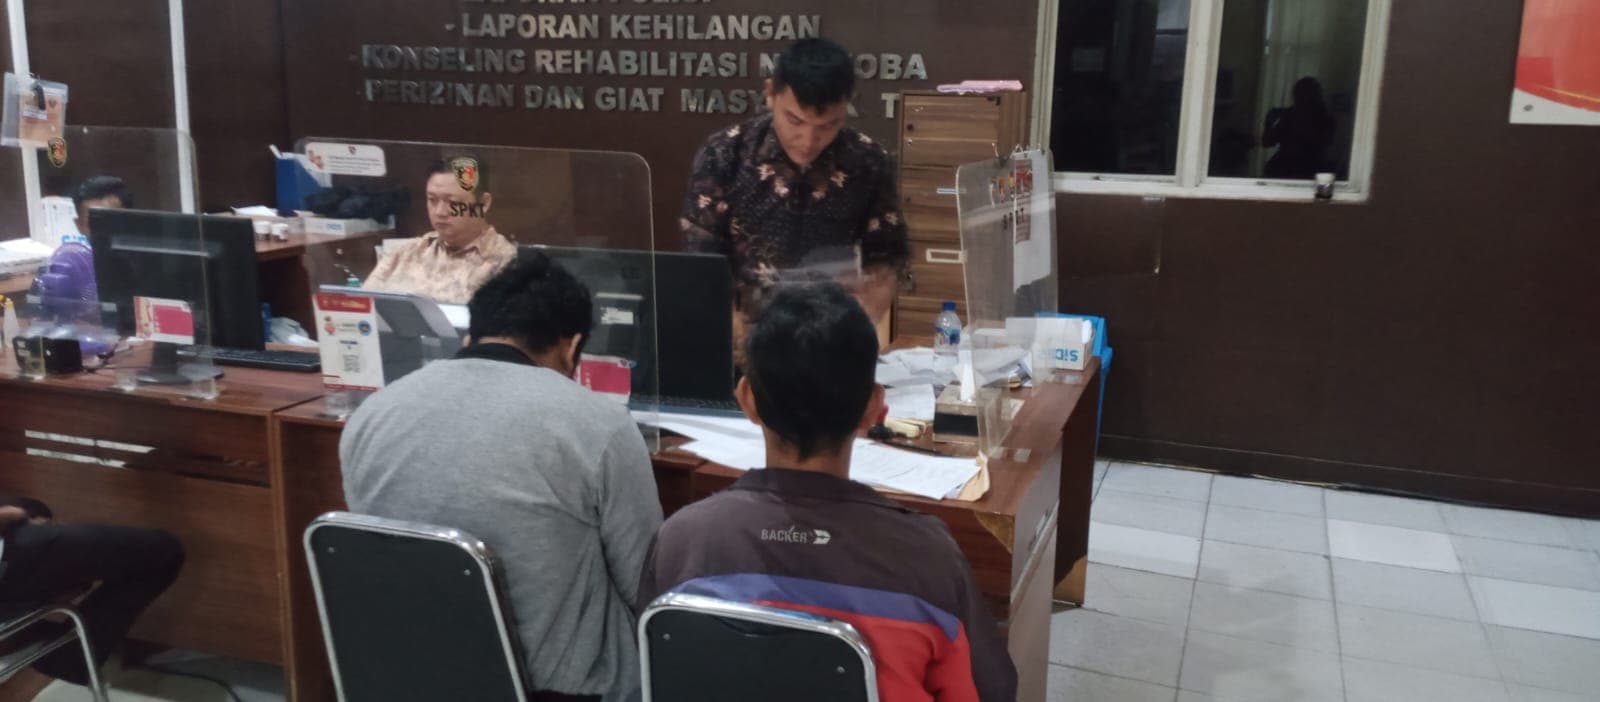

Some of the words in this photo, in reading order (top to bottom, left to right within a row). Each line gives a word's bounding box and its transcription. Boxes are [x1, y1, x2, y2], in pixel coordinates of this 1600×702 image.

[462, 13, 599, 39] LAPORAN
[610, 14, 821, 40] KEHILANGAN
[361, 44, 526, 73] KONSELING
[535, 49, 748, 77] REHABILITASI
[759, 52, 928, 80] NOBA
[365, 79, 514, 106] PERIZINAN
[525, 84, 585, 110] DAN
[595, 87, 664, 112] GIAT
[450, 201, 486, 218] SPKT
[761, 525, 807, 543] BACKER
